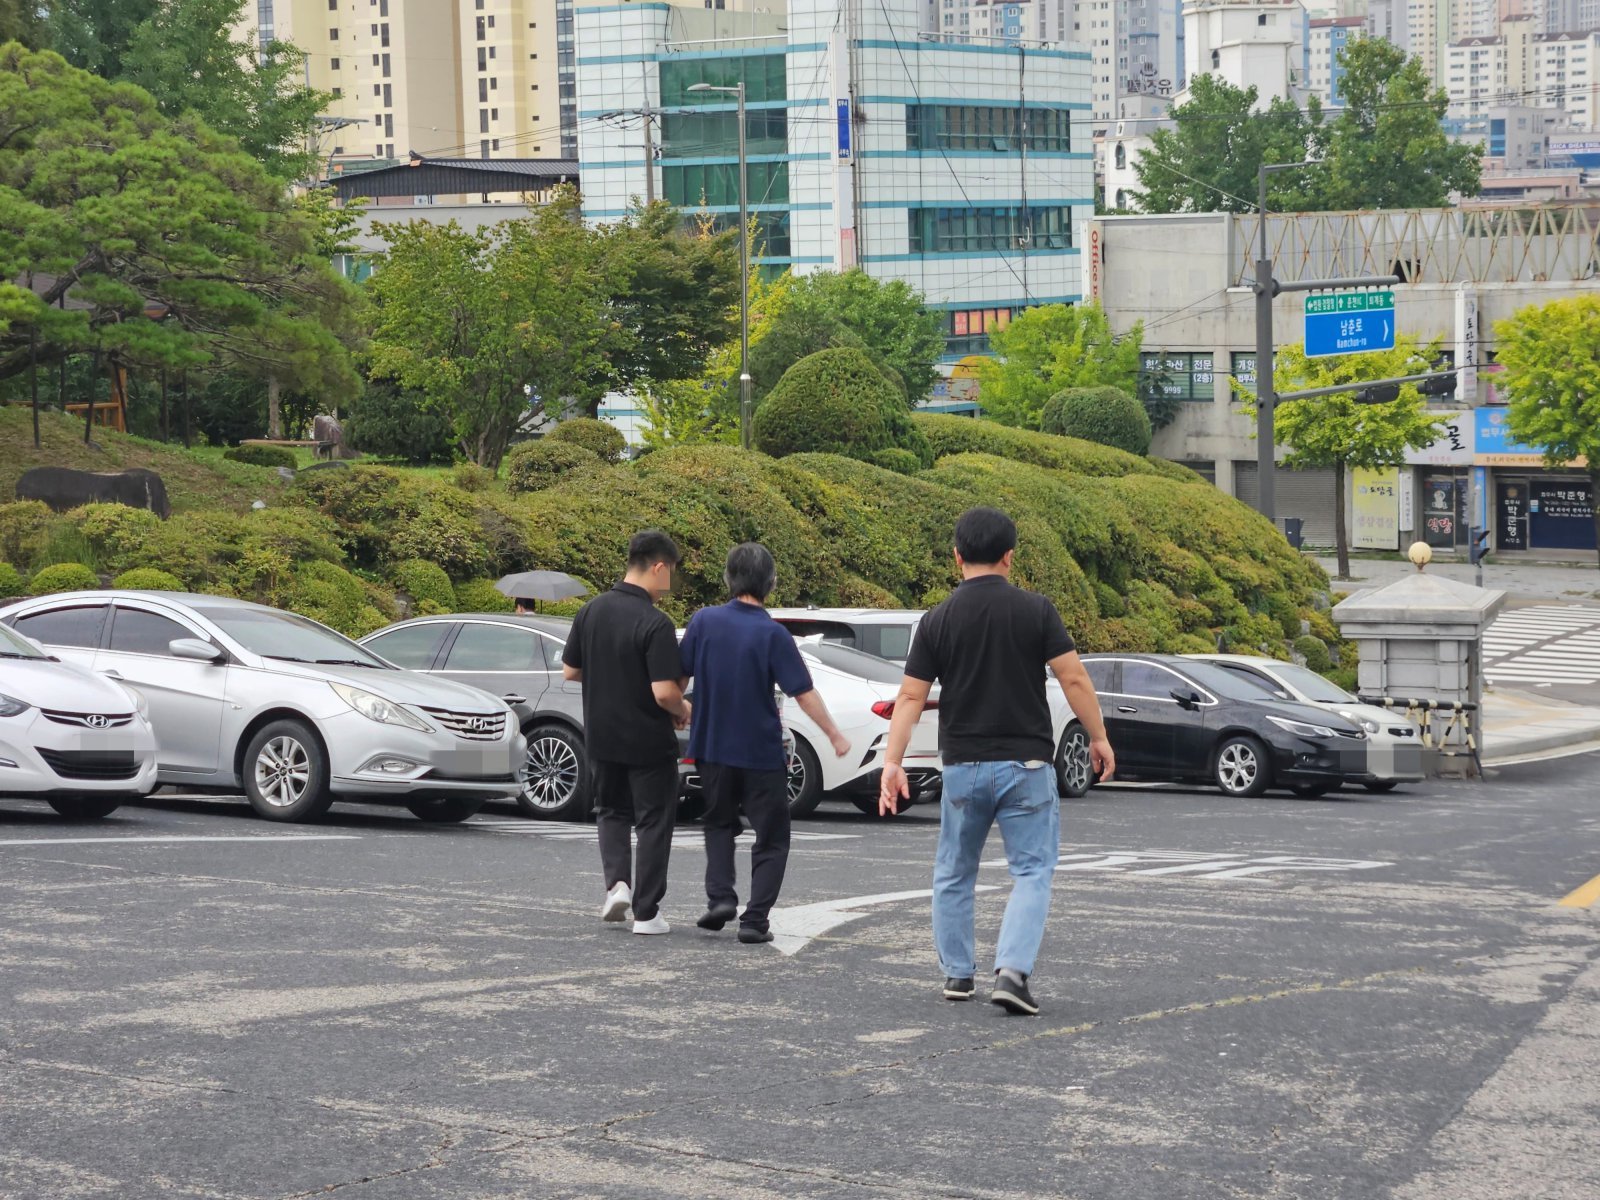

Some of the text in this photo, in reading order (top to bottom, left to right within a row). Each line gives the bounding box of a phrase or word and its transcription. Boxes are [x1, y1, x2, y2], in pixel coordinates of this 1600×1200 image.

[1091, 230, 1099, 282] Office
[1340, 318, 1363, 336] 남춘로
[1336, 338, 1367, 348] Namchun-ro
[1193, 359, 1213, 370] 전문
[1193, 373, 1213, 383] (2층)
[1427, 517, 1453, 534] 식당
